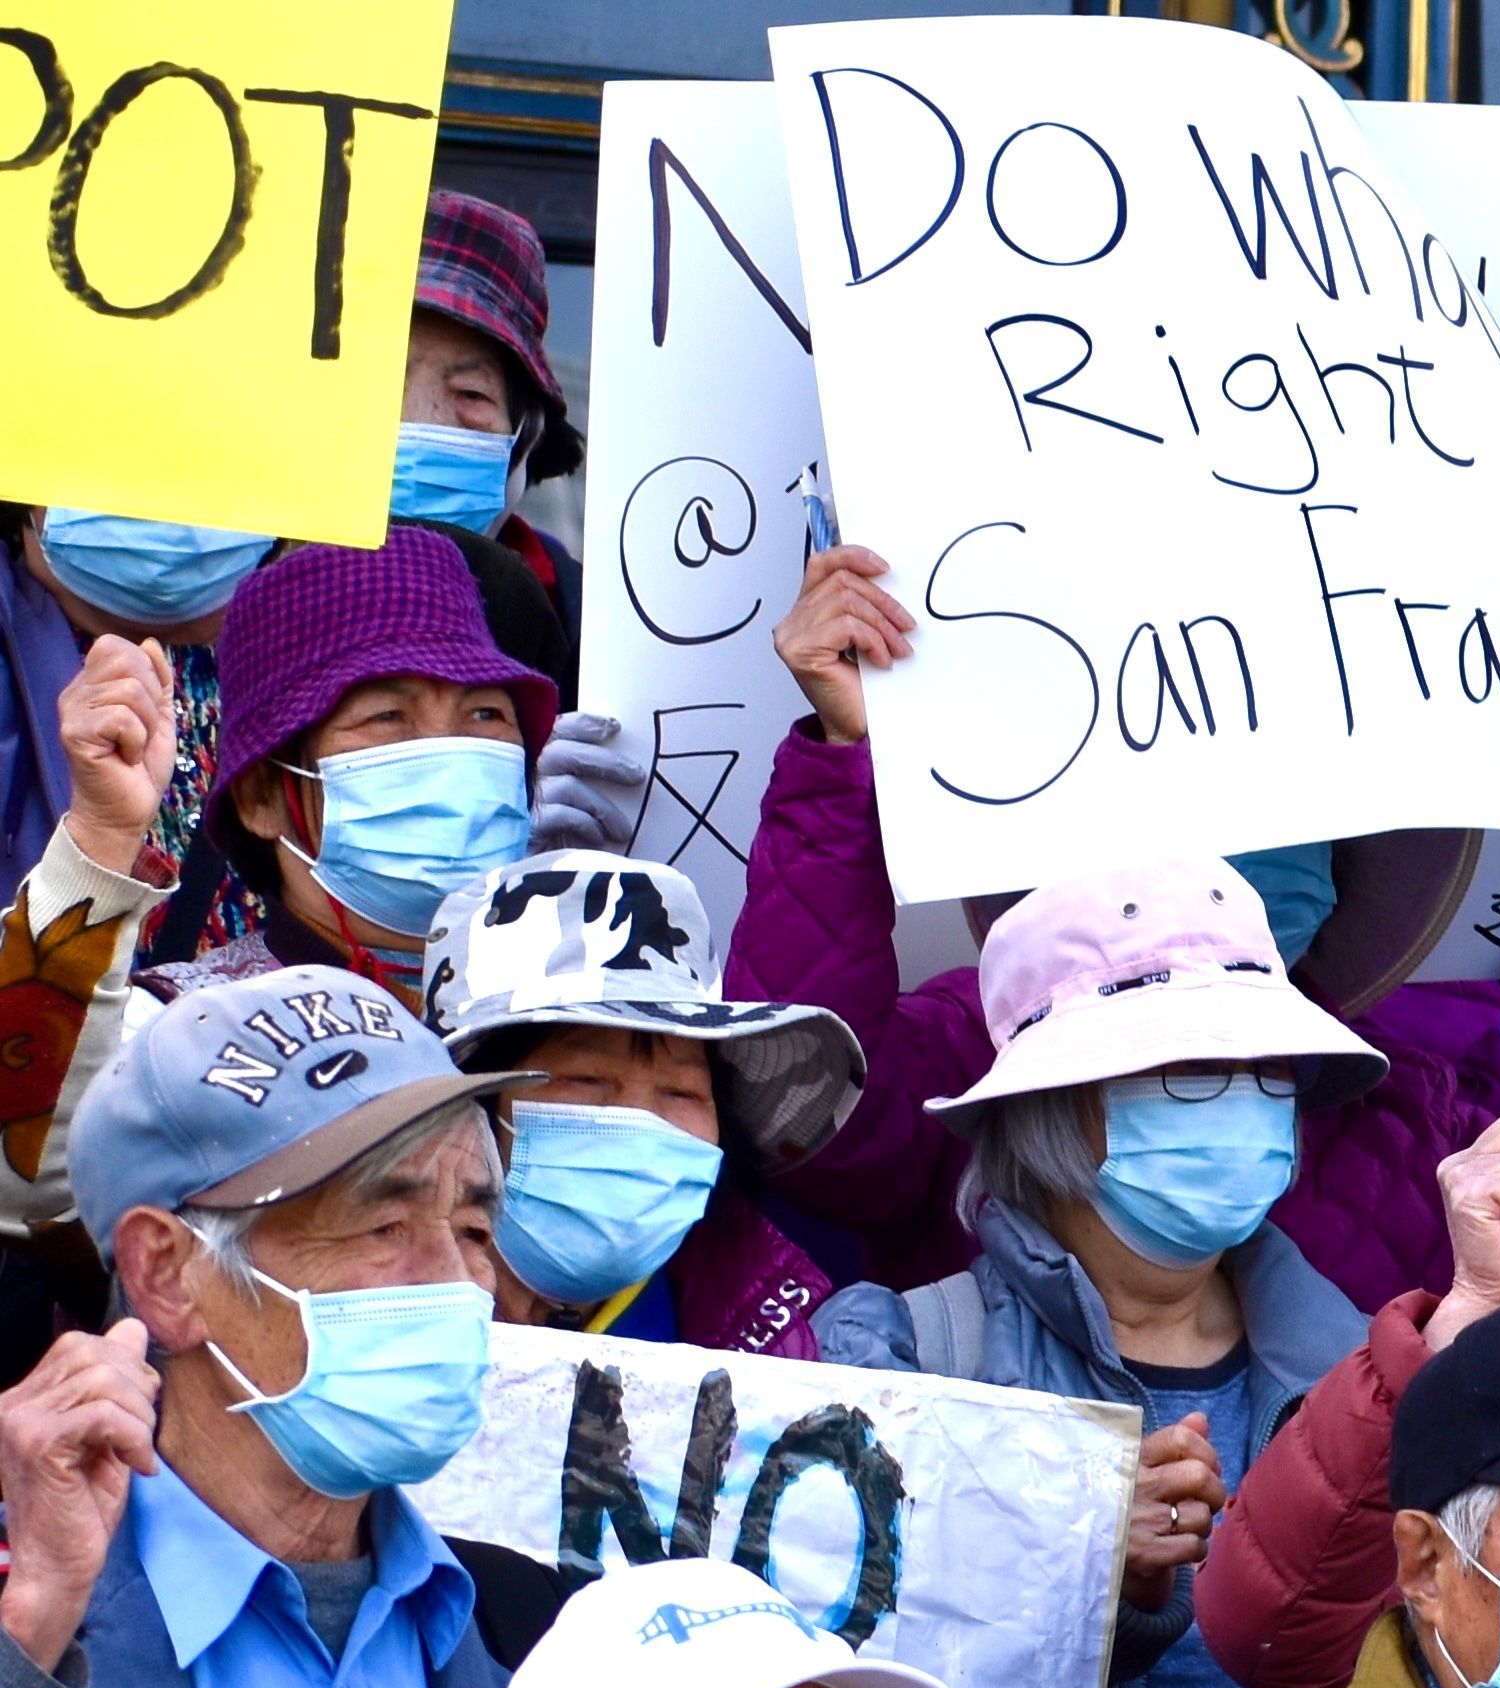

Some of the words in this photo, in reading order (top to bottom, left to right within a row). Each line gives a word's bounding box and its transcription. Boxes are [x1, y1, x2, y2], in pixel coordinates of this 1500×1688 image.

[985, 313, 1475, 495] Right
[925, 520, 1260, 806] San
[200, 989, 404, 1107] NIKE
[557, 1358, 910, 1650] NO
